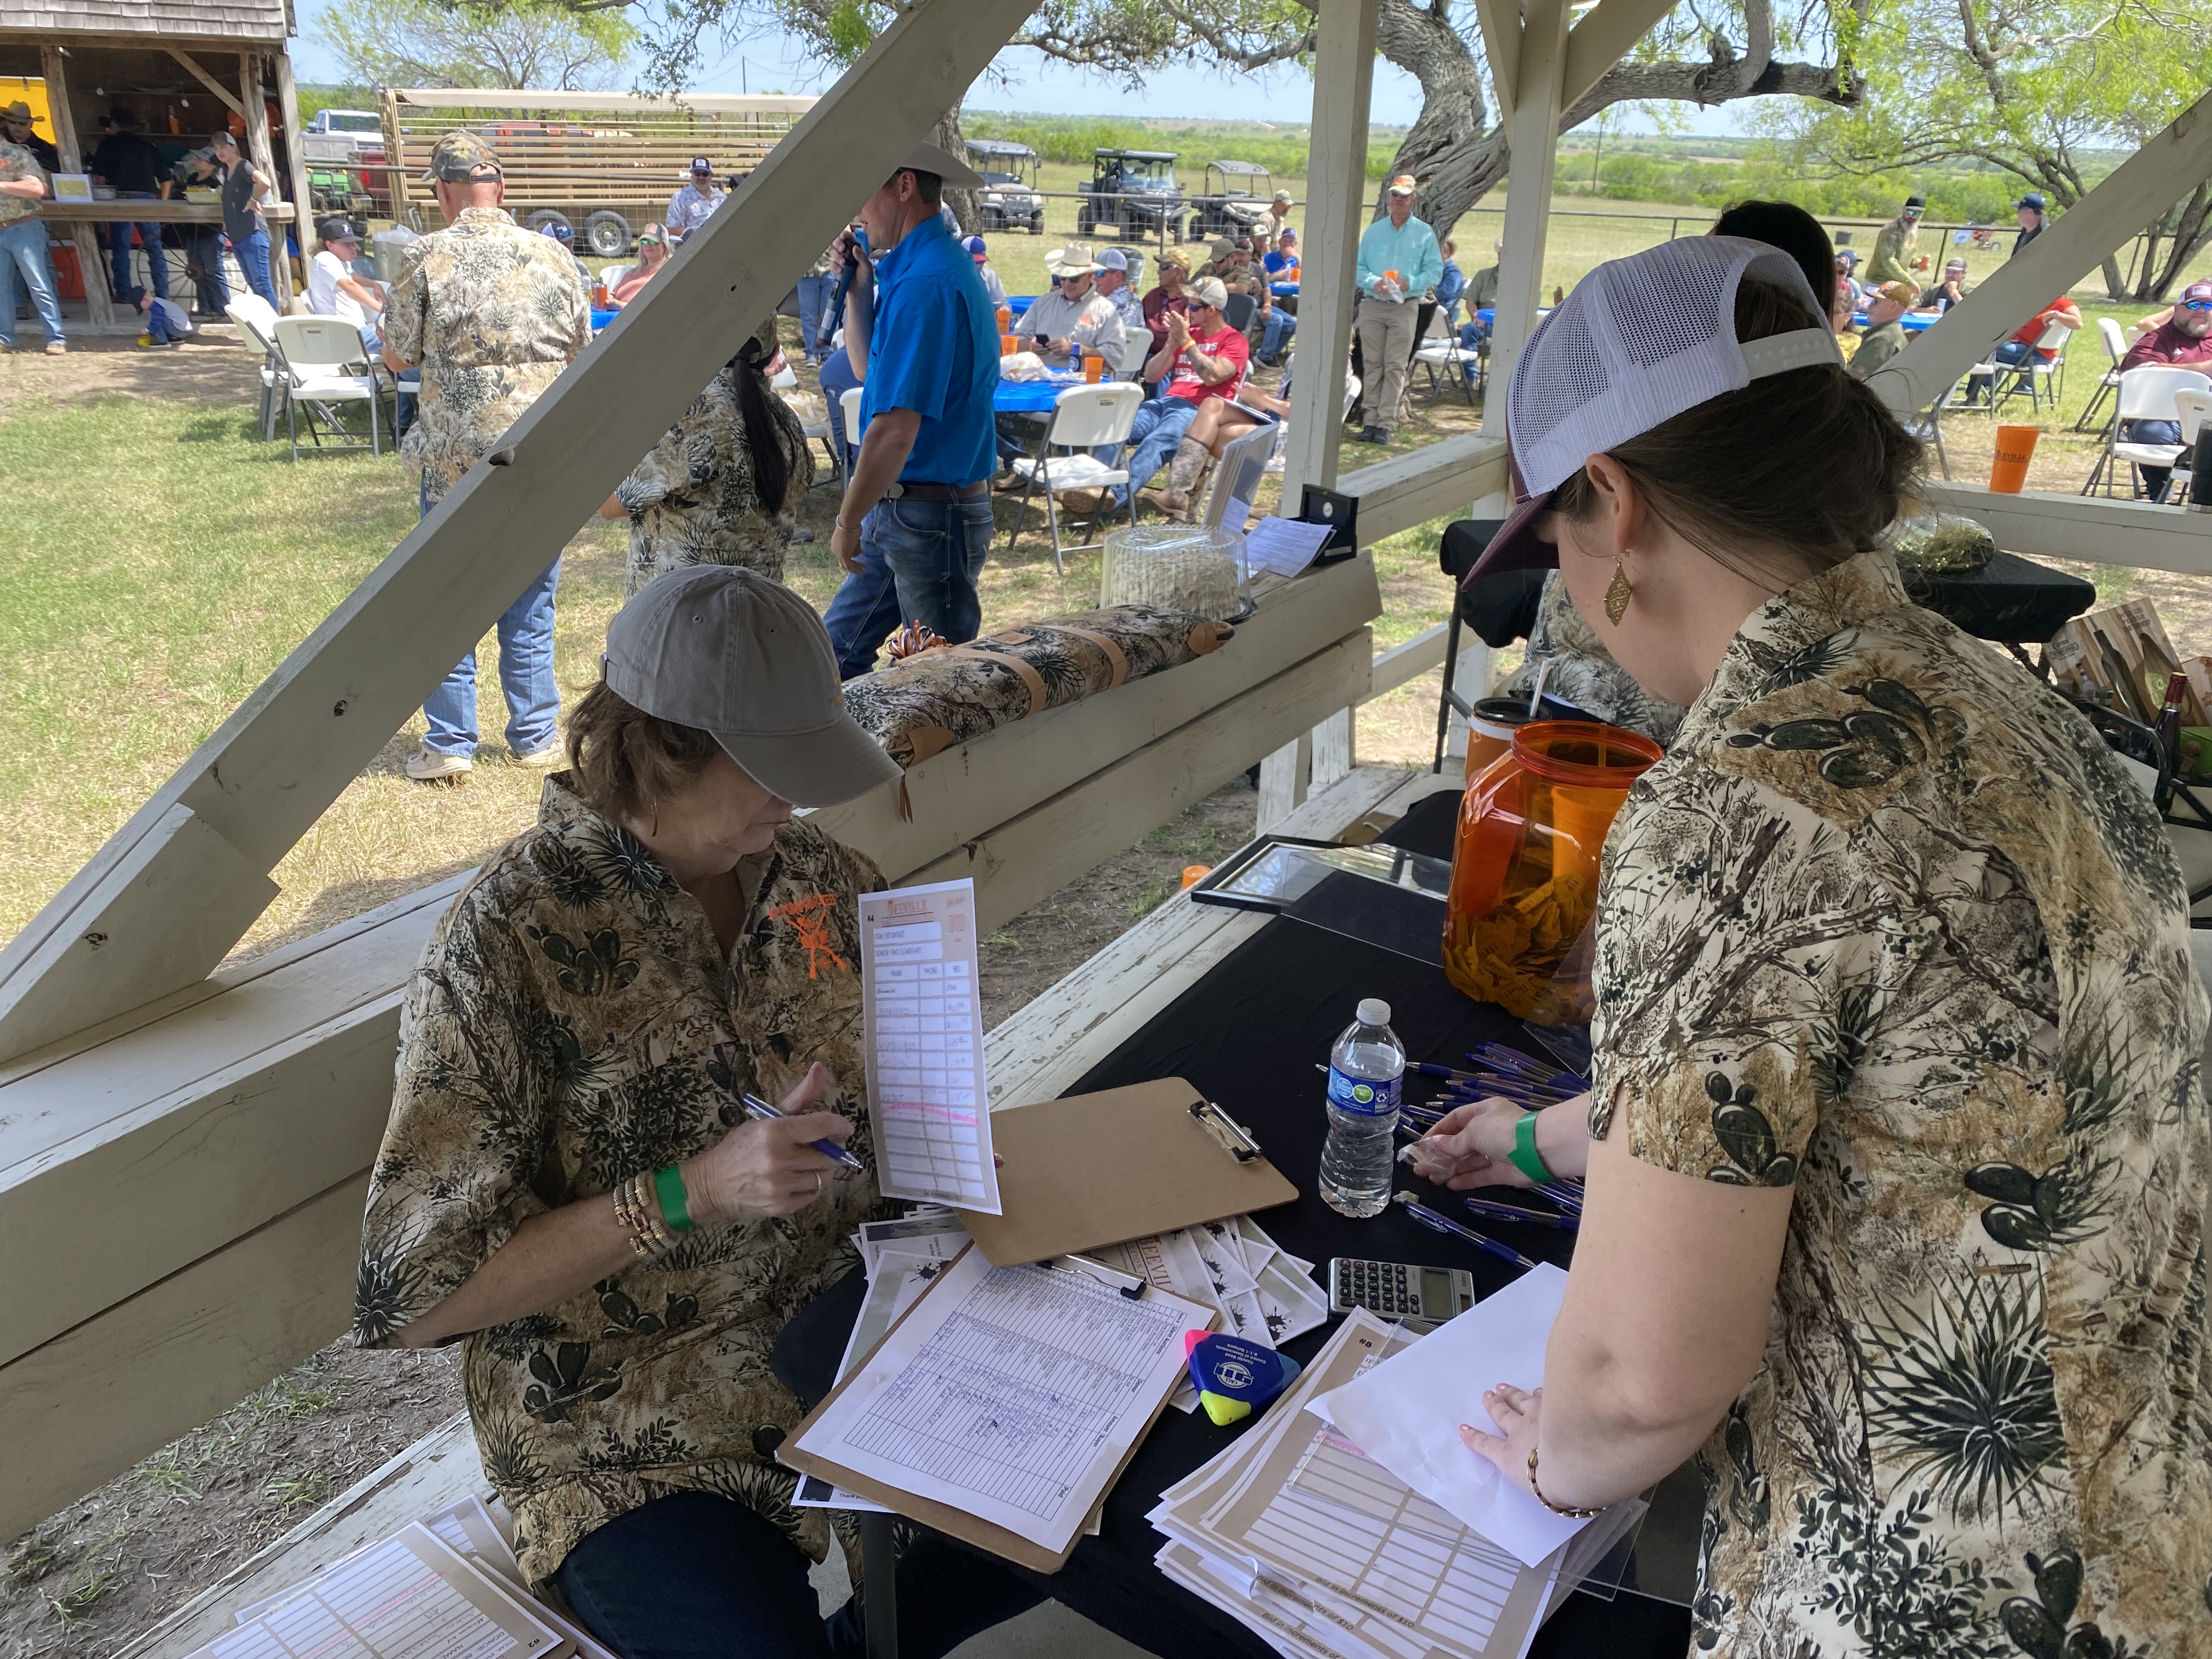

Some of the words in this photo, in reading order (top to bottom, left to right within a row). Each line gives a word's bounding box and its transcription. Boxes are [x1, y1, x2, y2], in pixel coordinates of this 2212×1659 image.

[948, 913, 966, 932] BID
[1138, 1322, 1148, 1332] Basket
[1144, 1325, 1154, 1335] Basket
[1166, 1325, 1178, 1338] Silent
[1154, 1337, 1171, 1355] Auctions
[1227, 1344, 1245, 1352] Network
[1359, 1338, 1372, 1348] #8
[1215, 1345, 1244, 1357] Governments
[1237, 1356, 1254, 1365] Coastal
[1249, 1356, 1266, 1364] Council
[1129, 1378, 1143, 1393] Donor
[1102, 1415, 1118, 1432] Amount
[1091, 1433, 1105, 1448] Buyer
[1057, 1485, 1069, 1498] Paid
[1256, 1575, 1273, 1586] Bid
[1327, 1612, 1339, 1623] of
[1337, 1617, 1355, 1630] $10
[1315, 1577, 1331, 1588] Bid
[1339, 1585, 1386, 1612] increments
[1385, 1611, 1399, 1620] of
[1397, 1615, 1415, 1628] $10
[473, 1630, 506, 1654] DONOR:
[1261, 1612, 1277, 1623] Bid
[1276, 1620, 1285, 1628] in
[1283, 1623, 1331, 1654] increments
[1329, 1650, 1342, 1658] of
[493, 1638, 516, 1654] ITEM:
[526, 1637, 541, 1649] #2
